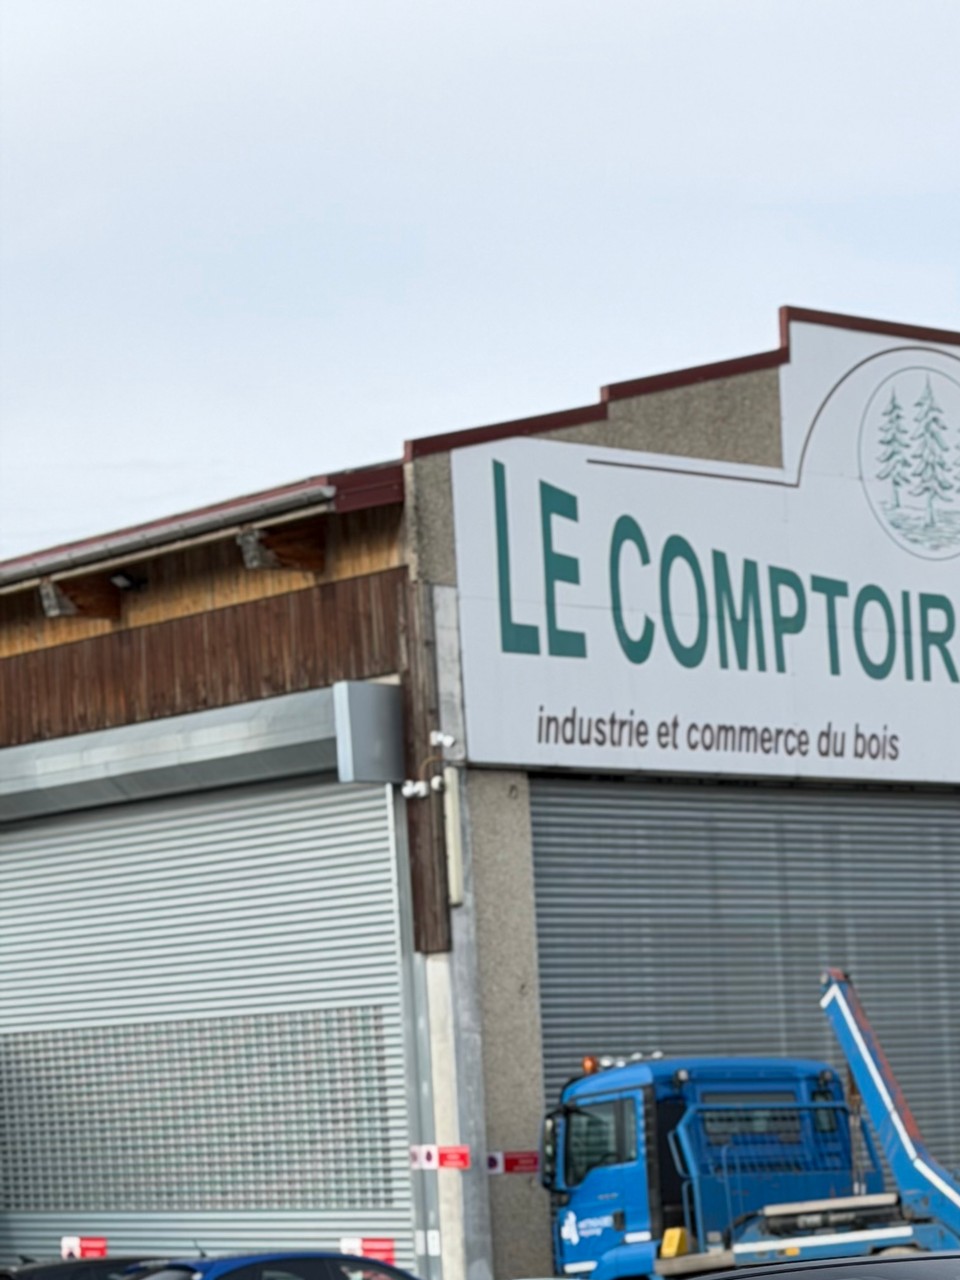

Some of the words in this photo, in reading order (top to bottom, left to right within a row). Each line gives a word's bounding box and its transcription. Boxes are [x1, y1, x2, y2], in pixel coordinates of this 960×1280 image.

[491, 458, 588, 660] LE
[608, 513, 960, 684] COMPTOIR
[537, 705, 649, 748] industrie
[656, 714, 680, 750] et
[686, 722, 810, 757] commerce
[816, 721, 846, 758] du
[853, 723, 900, 761] bois
